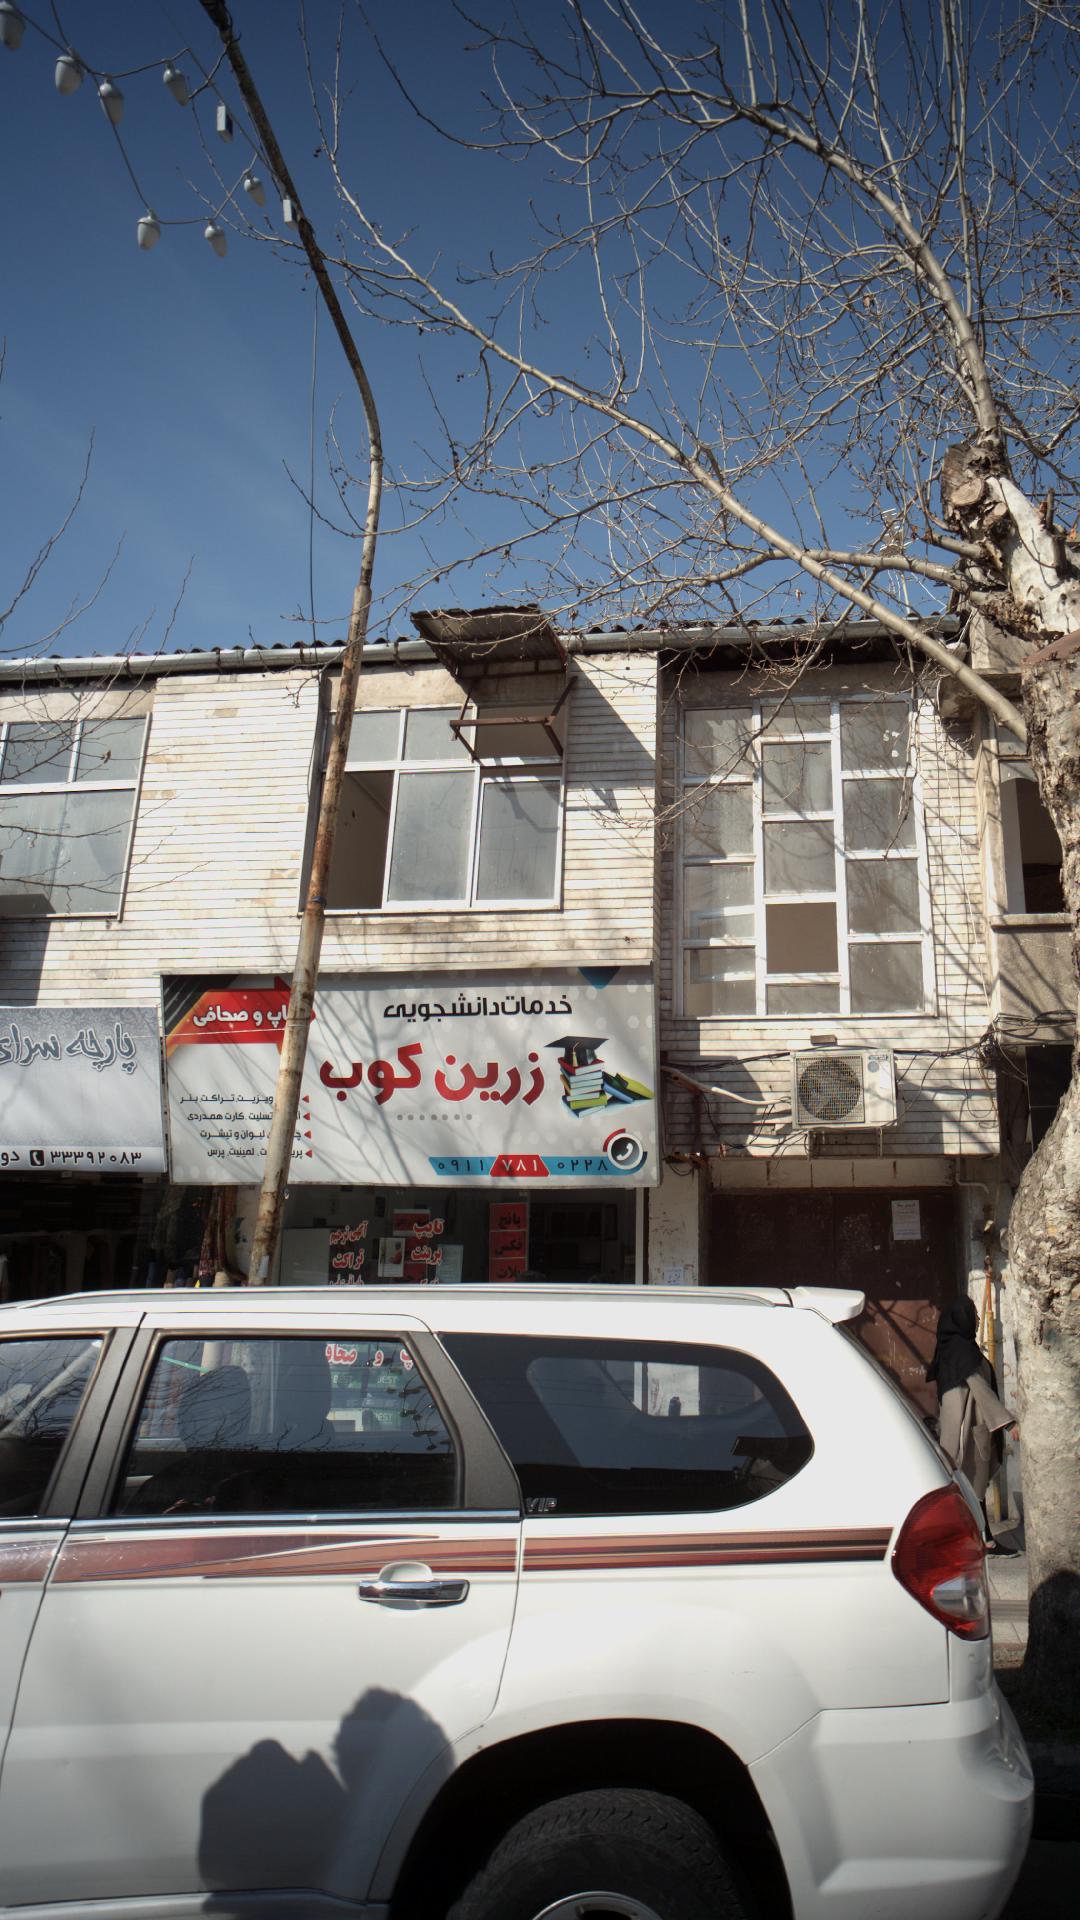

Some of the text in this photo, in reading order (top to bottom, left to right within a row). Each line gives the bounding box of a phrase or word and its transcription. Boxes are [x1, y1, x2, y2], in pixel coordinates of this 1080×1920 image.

[192, 1004, 288, 1029] اپ و صحافی
[383, 993, 573, 1022] خدمات دانشجویی
[65, 1022, 137, 1075] پارچه
[319, 1042, 545, 1106] زرین کوب
[186, 1112, 224, 1122] همدردی
[224, 1111, 245, 1122] کارت
[199, 1128, 265, 1141] لیوان و تیشرت
[50, 1151, 142, 1165] ۳۳۳۹۲۰۸۳
[207, 1148, 225, 1159] پرس
[437, 1158, 609, 1172] ۰۹۱۱ ۷۸۱ ۰۲۲۸
[413, 1218, 445, 1240] تایپ
[332, 1248, 365, 1270] تراکت
[411, 1245, 443, 1266] پرینت
[526, 1497, 558, 1512] VIP
